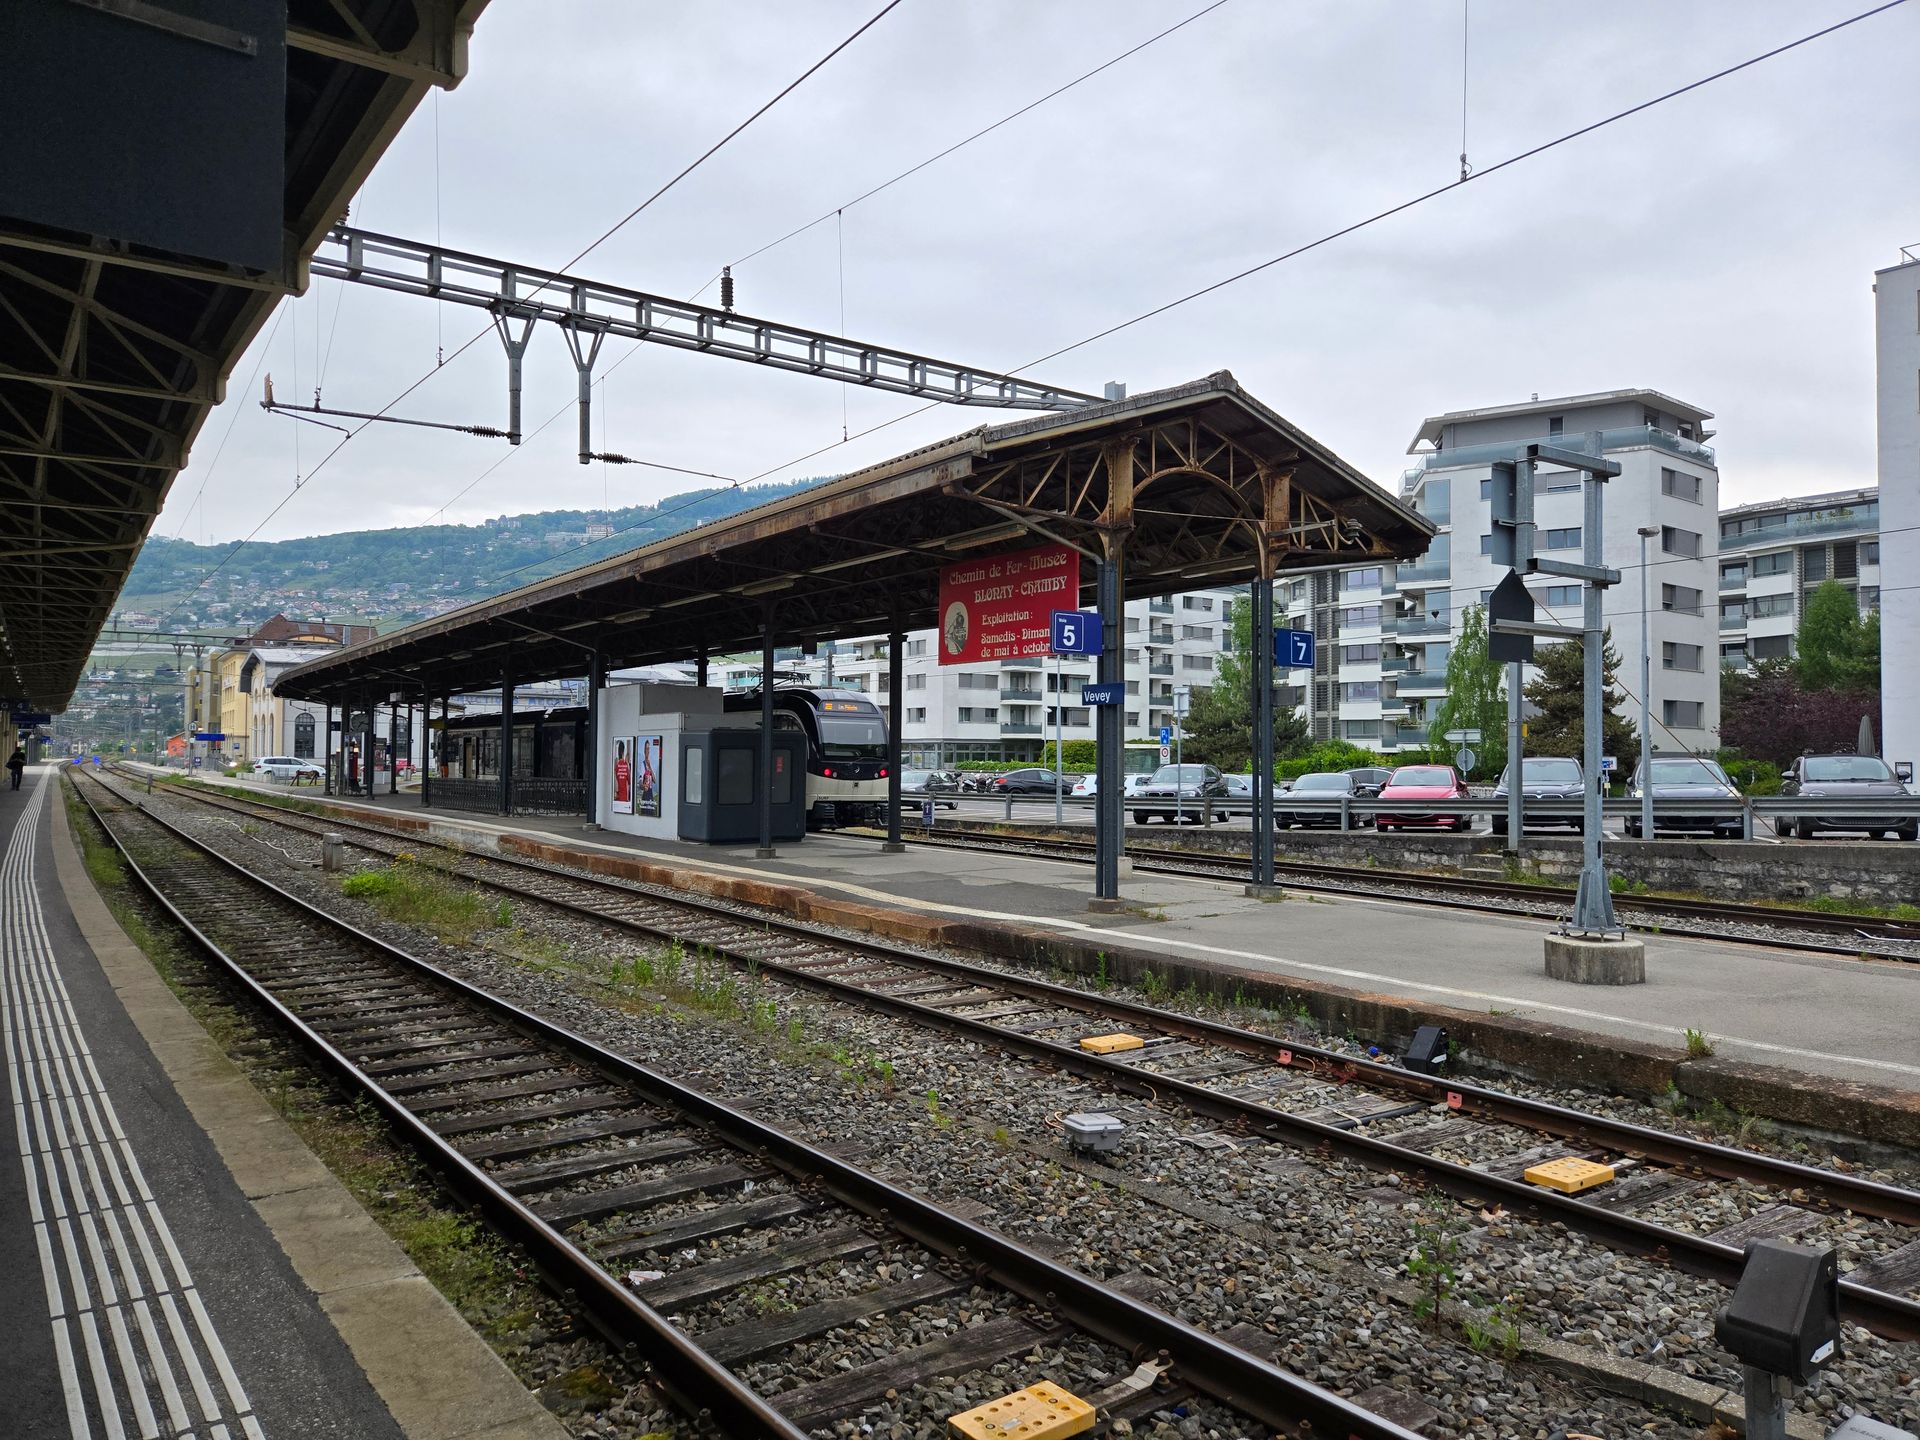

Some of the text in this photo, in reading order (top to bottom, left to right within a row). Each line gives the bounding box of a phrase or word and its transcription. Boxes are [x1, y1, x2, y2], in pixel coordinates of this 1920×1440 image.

[949, 567, 985, 585] Chemin
[988, 564, 1001, 578] de
[1006, 560, 1022, 575] Fer
[1029, 553, 1067, 571] Musée
[974, 585, 1014, 603] BLONAY
[981, 630, 1016, 644] Samedis
[1022, 628, 1050, 640] Diman
[1062, 625, 1075, 647] 5
[981, 642, 1050, 658] de mai à octobr
[1297, 642, 1307, 661] 7
[1084, 691, 1111, 703] Vevey
